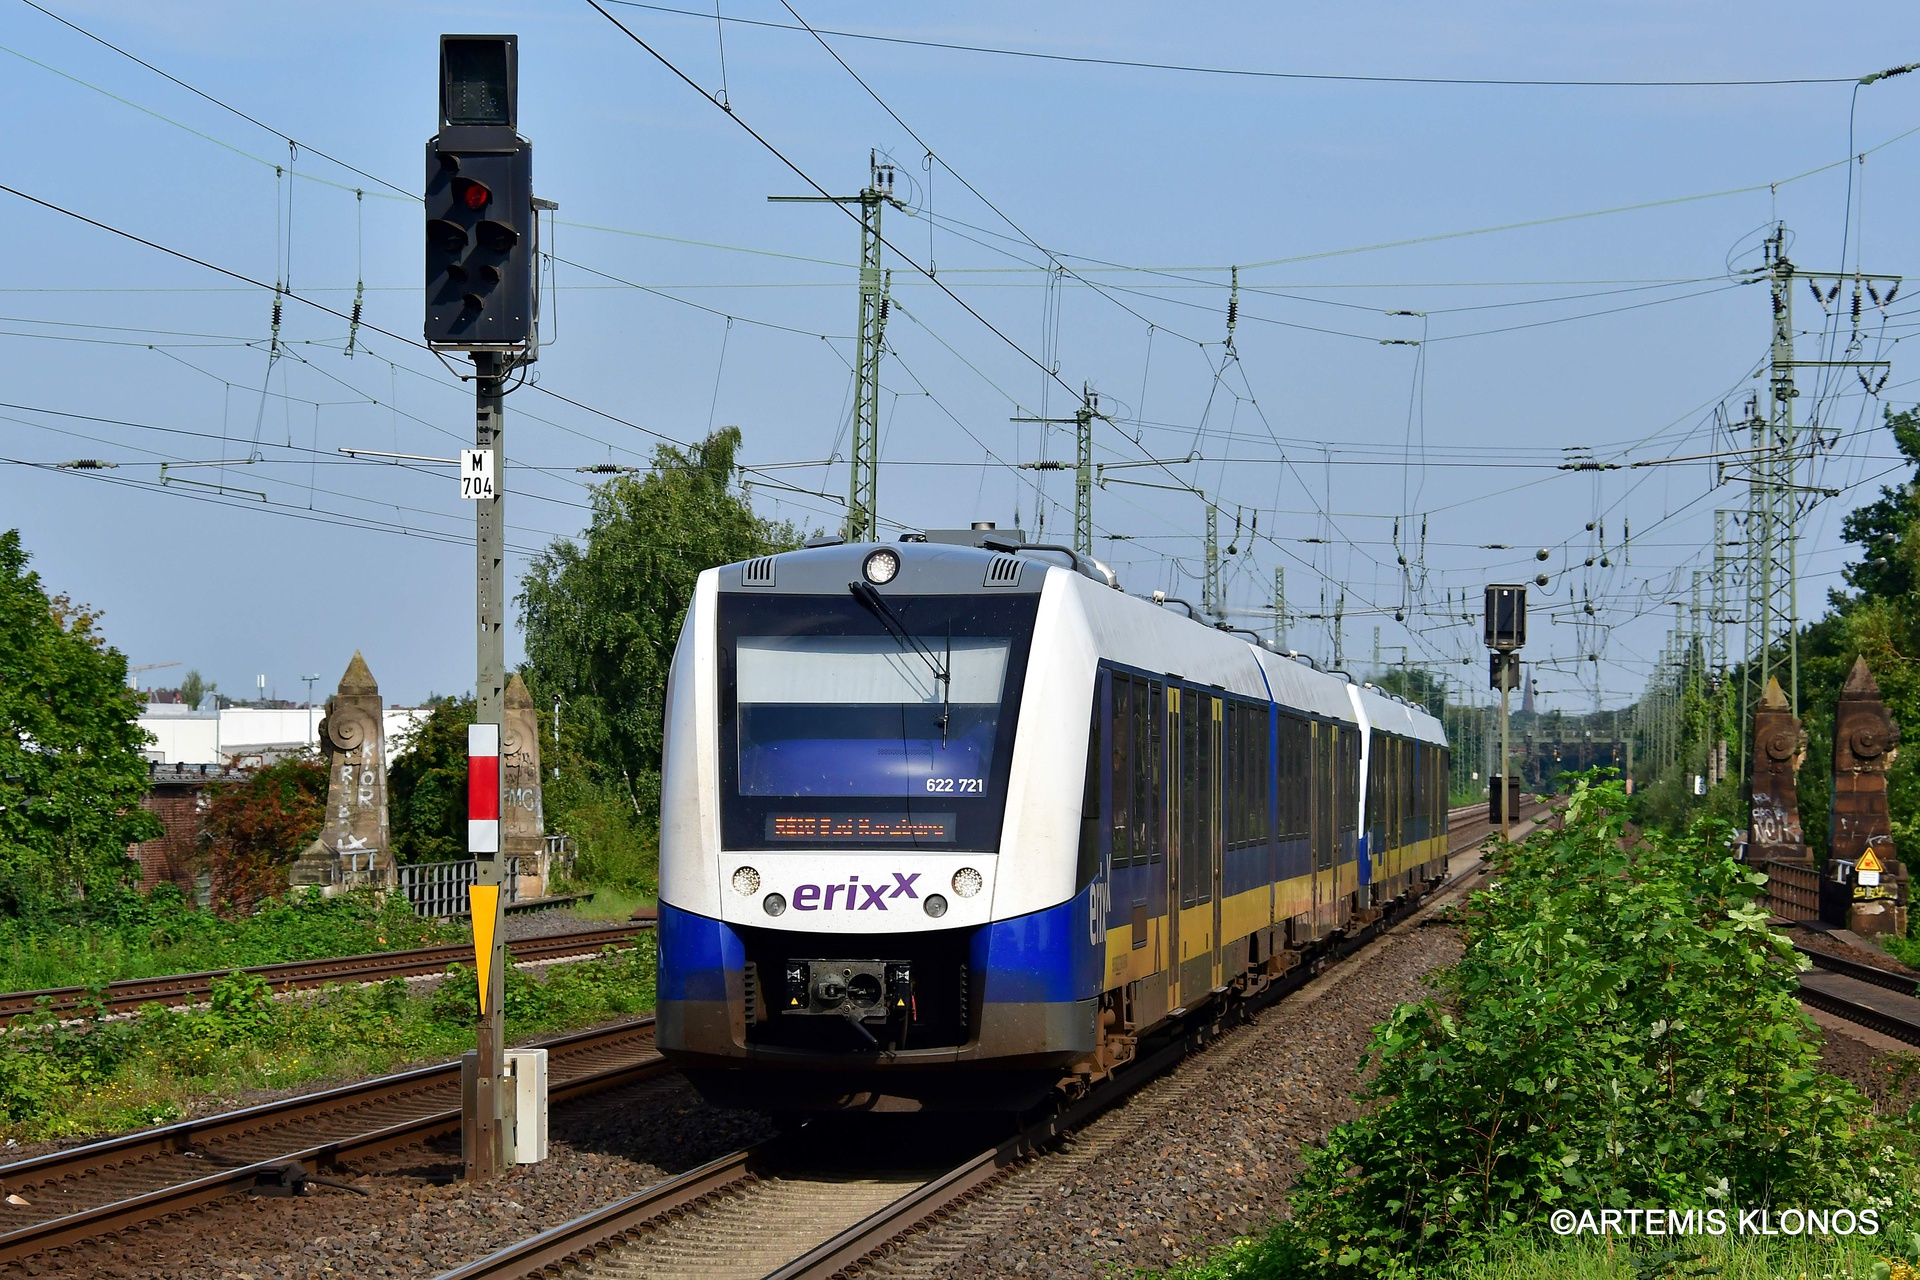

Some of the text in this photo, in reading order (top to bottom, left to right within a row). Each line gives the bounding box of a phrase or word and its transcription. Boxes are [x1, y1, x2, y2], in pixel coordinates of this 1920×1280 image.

[472, 453, 483, 472] M
[463, 477, 492, 495] 704
[926, 778, 983, 793] 622 721
[792, 872, 922, 911] erixx
